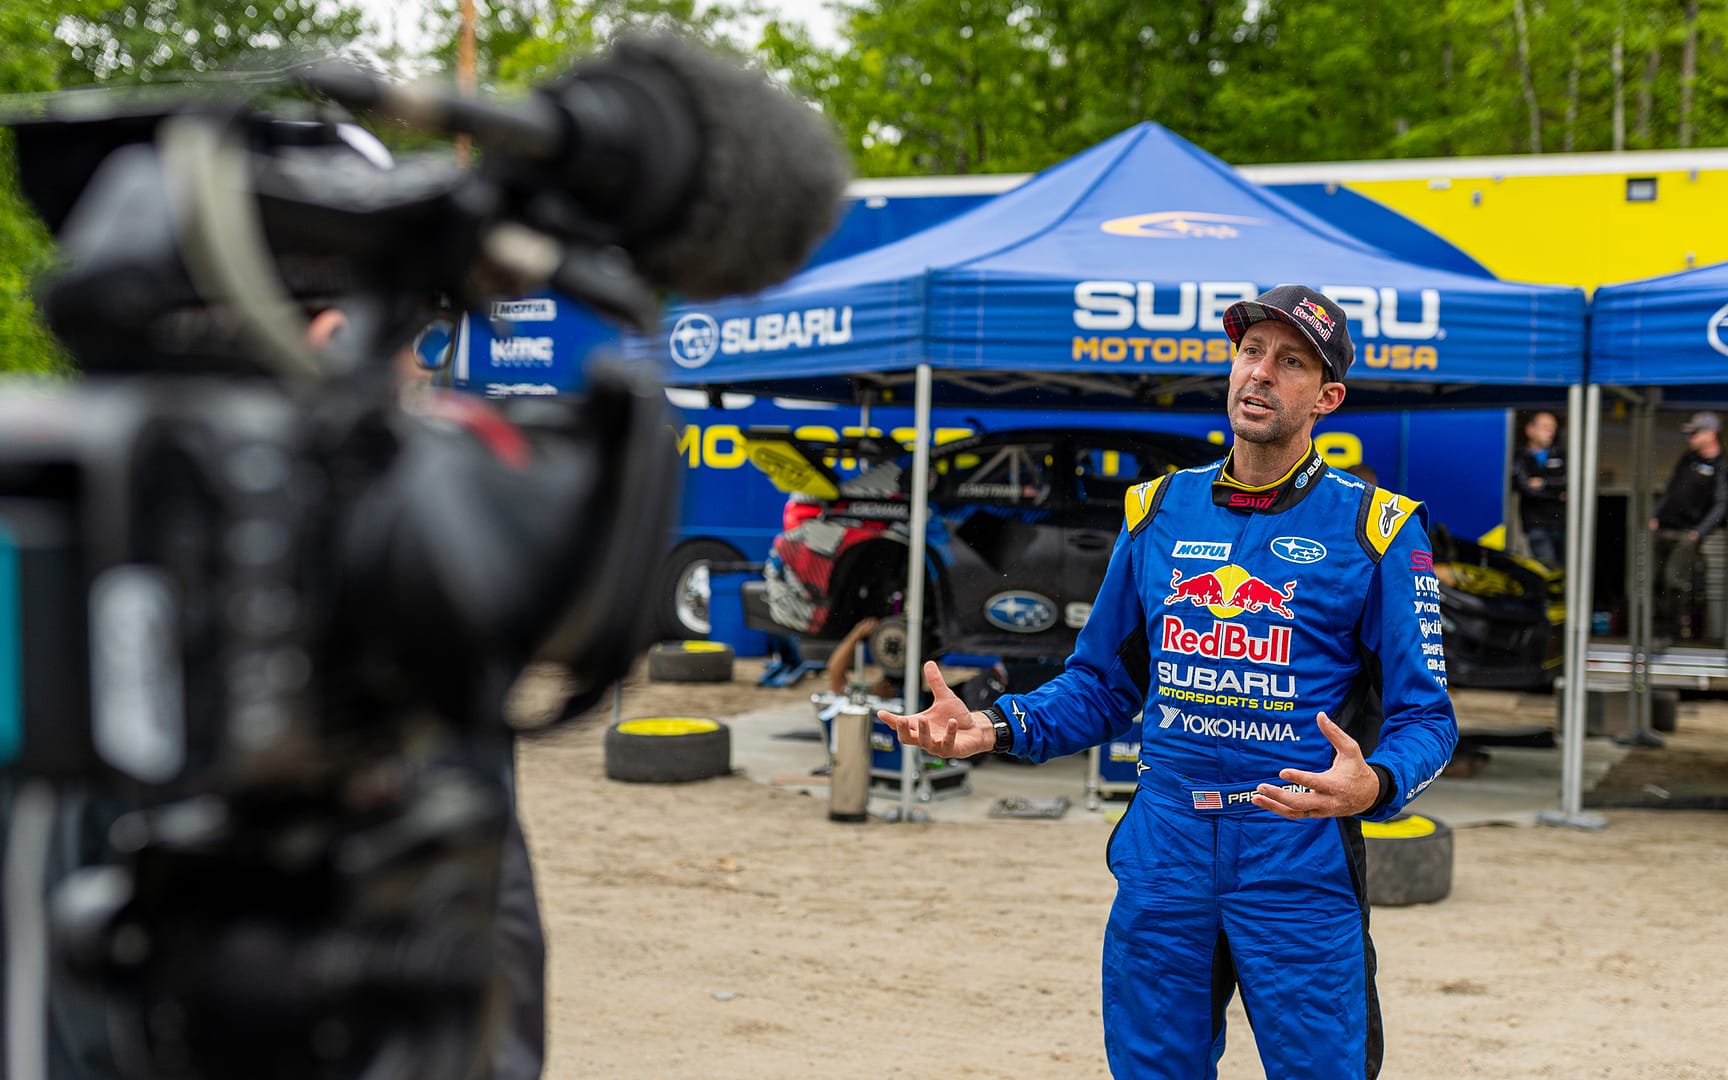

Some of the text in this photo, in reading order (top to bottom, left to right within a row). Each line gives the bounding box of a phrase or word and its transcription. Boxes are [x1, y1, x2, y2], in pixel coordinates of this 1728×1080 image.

[1073, 281, 1440, 339] SUBRU
[721, 306, 852, 355] SUBARU
[1365, 345, 1439, 369] USA
[1176, 544, 1227, 557] MOTUL
[1157, 661, 1297, 698] SUBARU
[1158, 685, 1294, 711] MOTORSPORTS USA
